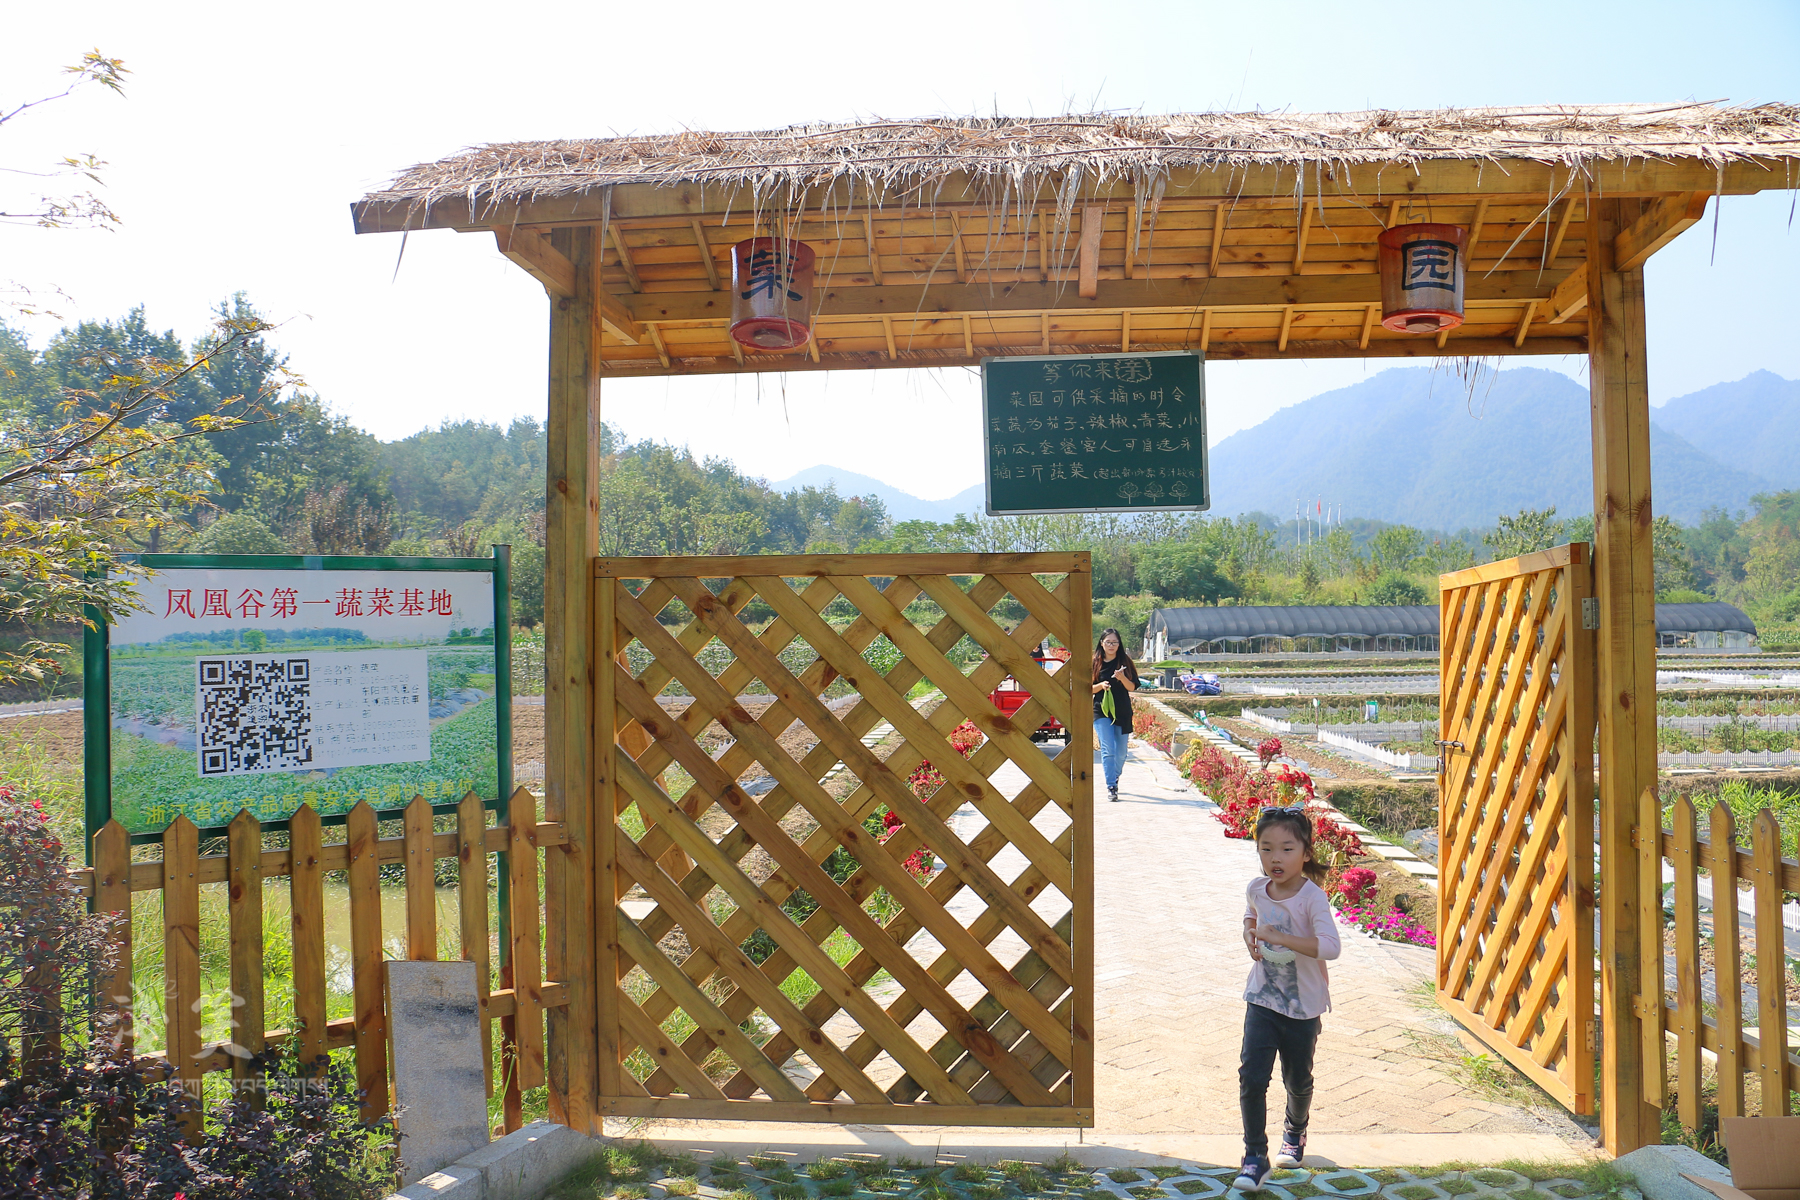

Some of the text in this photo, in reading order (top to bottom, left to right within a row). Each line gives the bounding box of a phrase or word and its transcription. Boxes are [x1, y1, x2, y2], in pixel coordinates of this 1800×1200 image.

[1009, 386, 1186, 409] 菜园可供采摘的时令
[163, 587, 453, 619] 凤凰谷第一蔬菜基地
